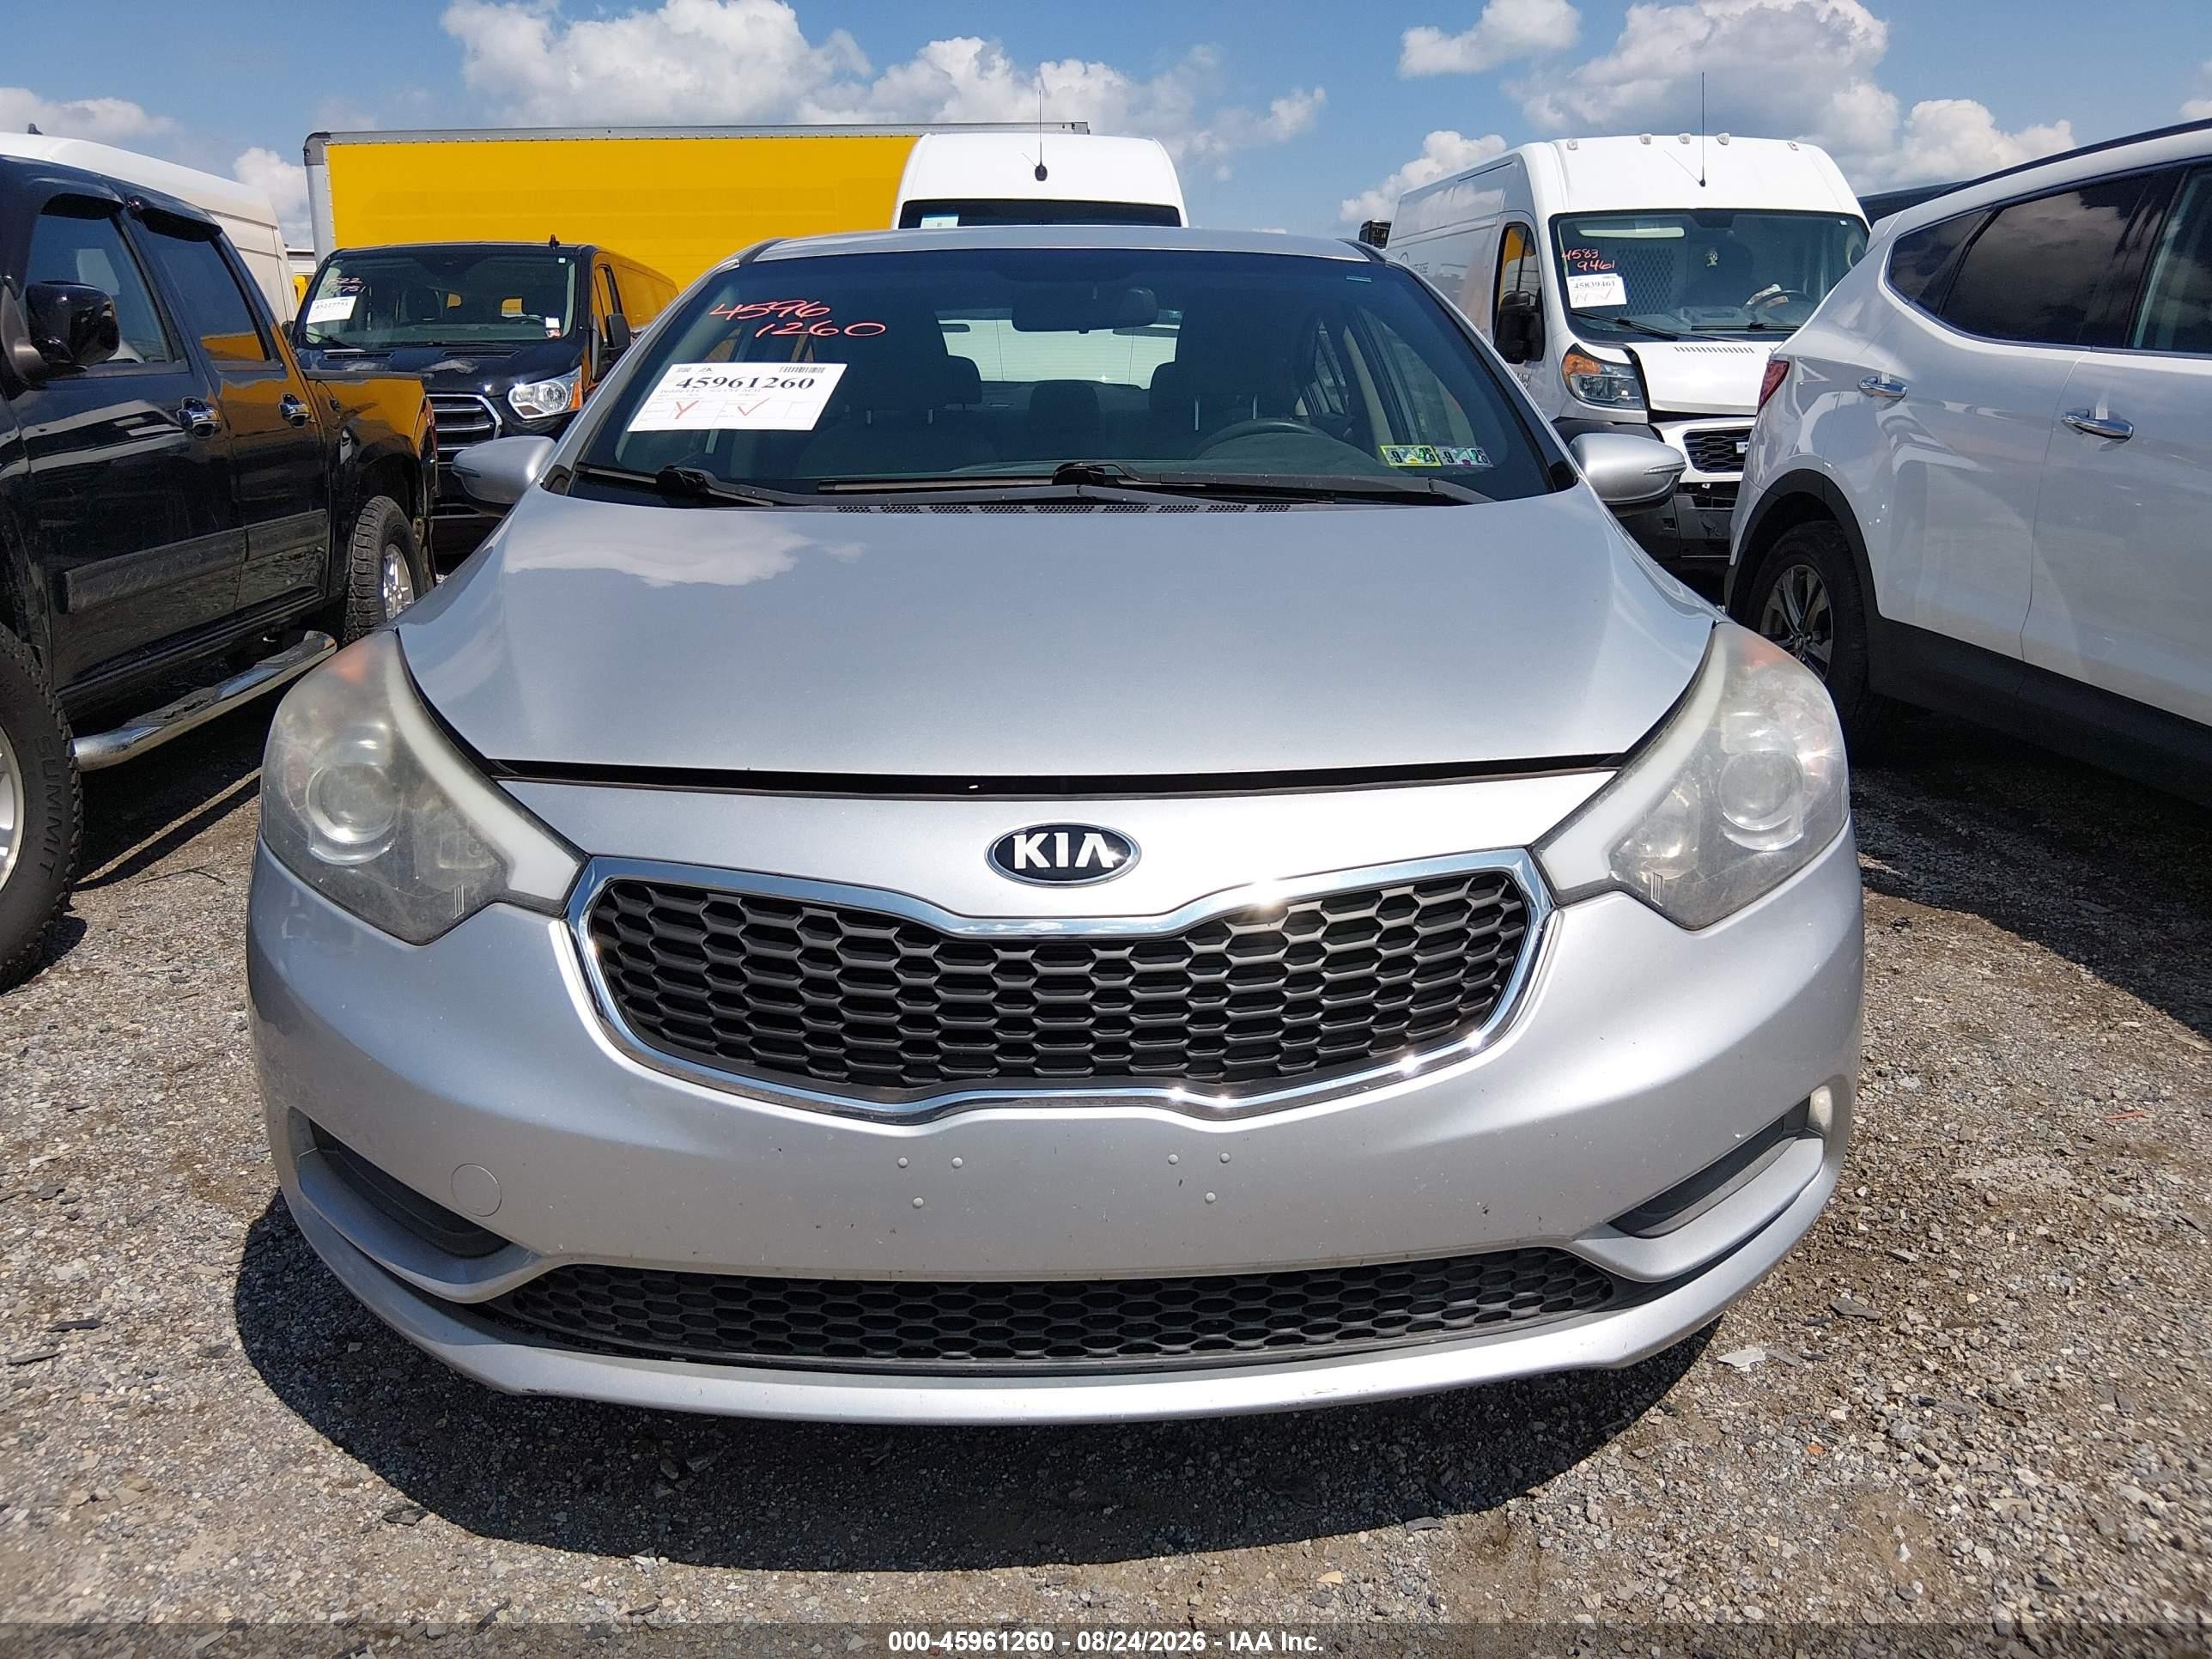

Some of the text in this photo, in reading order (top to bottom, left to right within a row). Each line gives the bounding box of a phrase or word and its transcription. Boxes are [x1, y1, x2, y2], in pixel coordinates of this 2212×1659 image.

[1561, 248, 1599, 261] 4583
[1577, 259, 1615, 271] 9461
[708, 300, 831, 321] 4596
[755, 320, 887, 338] 1260
[675, 376, 816, 389] 45961260
[35, 735, 63, 880] SUMMIT
[1012, 832, 1115, 869] KIA
